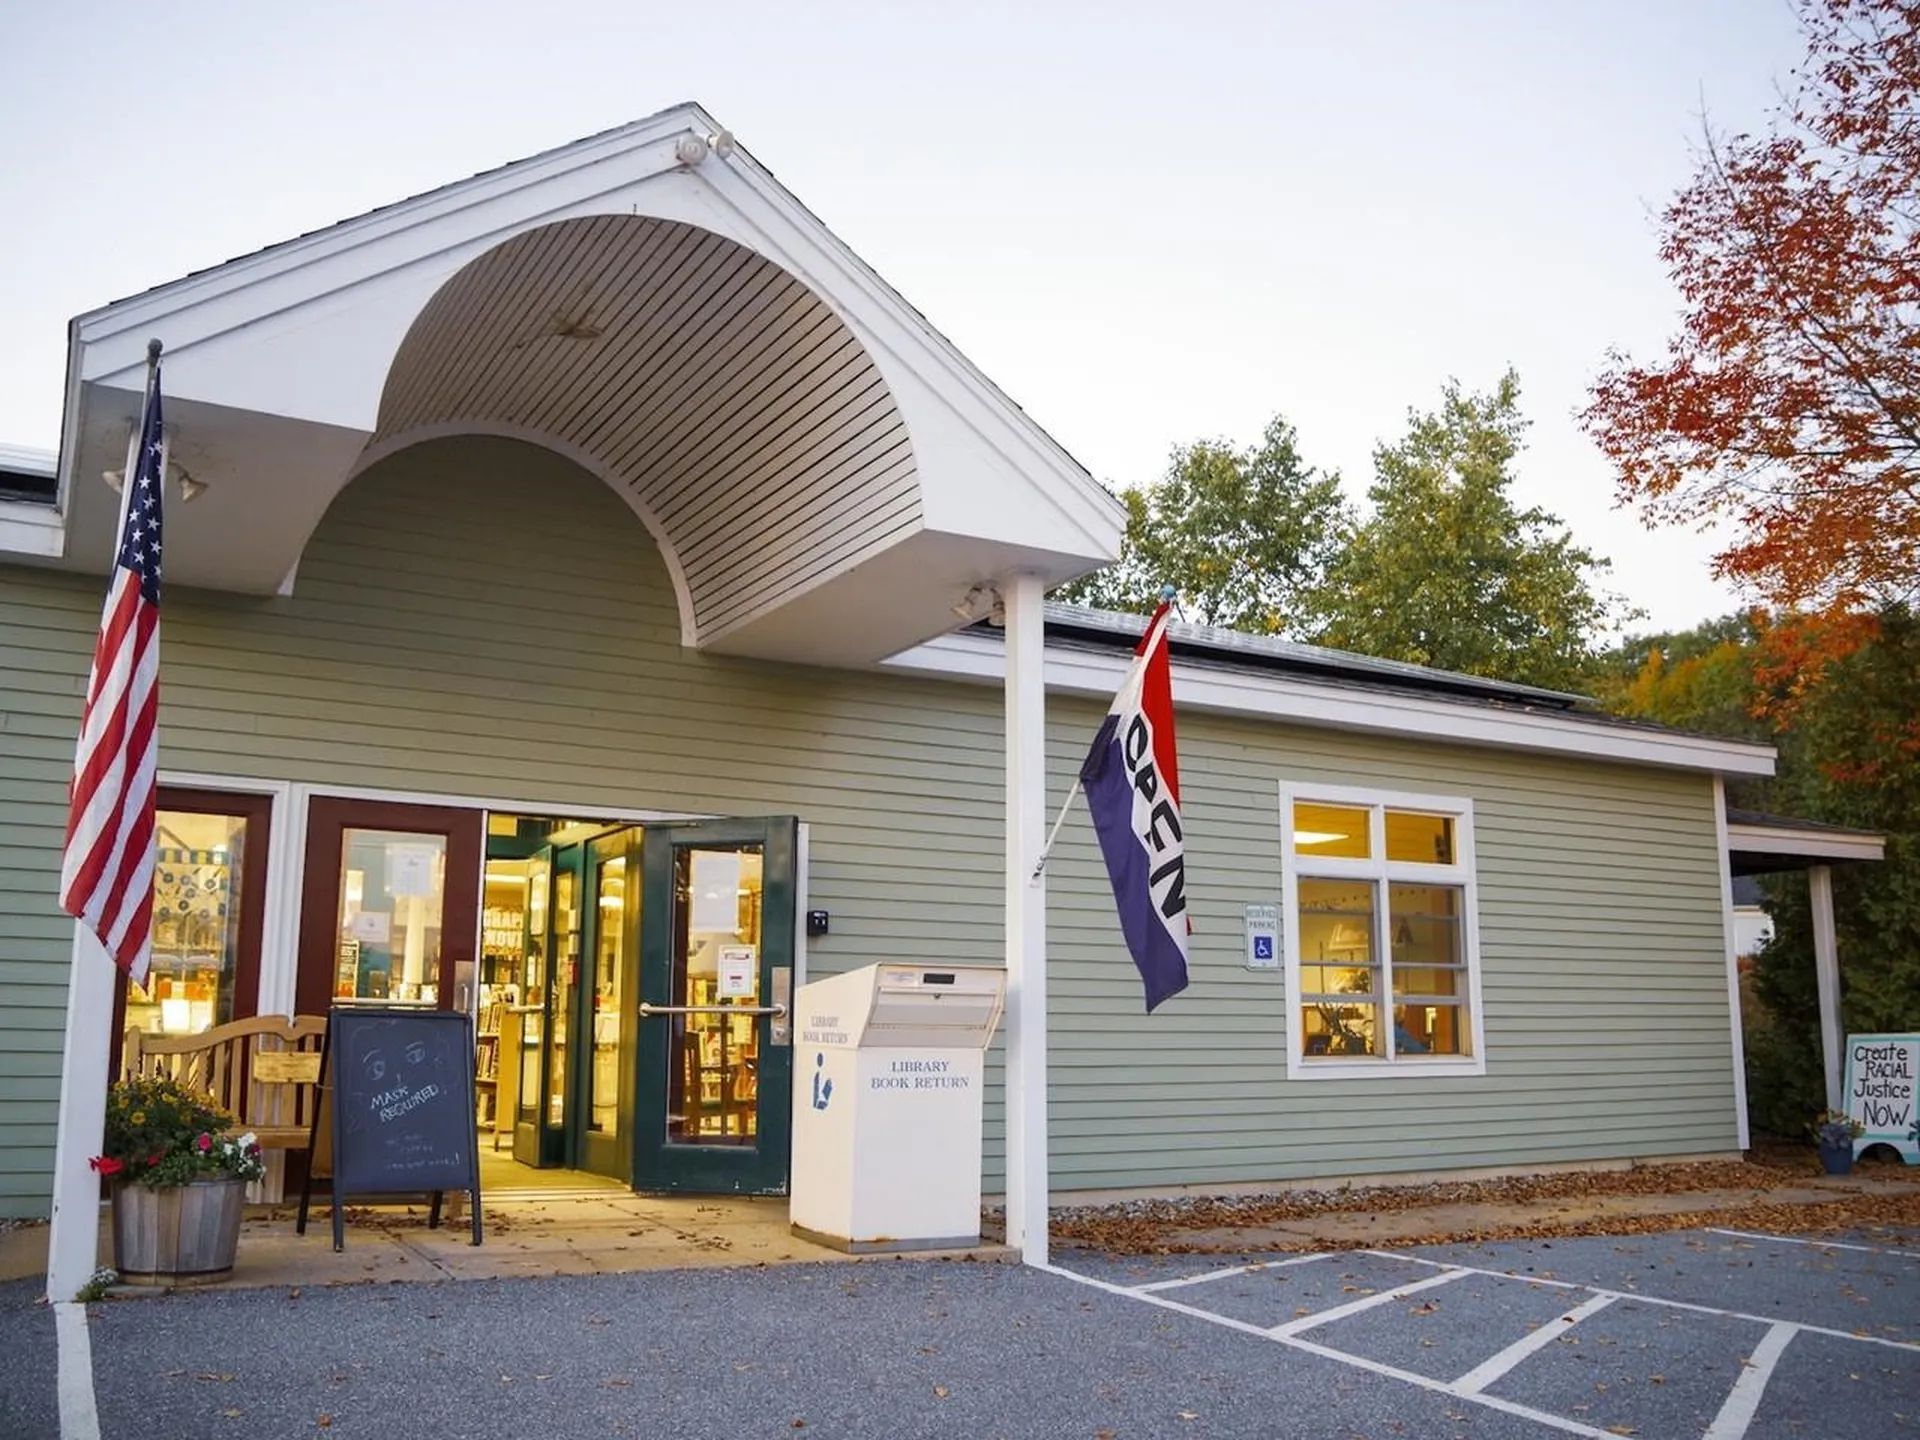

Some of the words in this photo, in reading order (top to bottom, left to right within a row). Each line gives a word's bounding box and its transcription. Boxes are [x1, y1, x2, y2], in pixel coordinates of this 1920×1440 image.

[1126, 713, 1186, 919] OPEN
[891, 1061, 949, 1073] LIBRARY
[1865, 1061, 1914, 1079] RACIAL
[871, 1077, 909, 1089] BOOK
[914, 1076, 970, 1089] RETURN
[1853, 1079, 1911, 1098] Justice
[370, 1085, 409, 1110] MASK
[379, 1083, 440, 1122] REQUIRED
[1863, 1100, 1911, 1127] NOW
